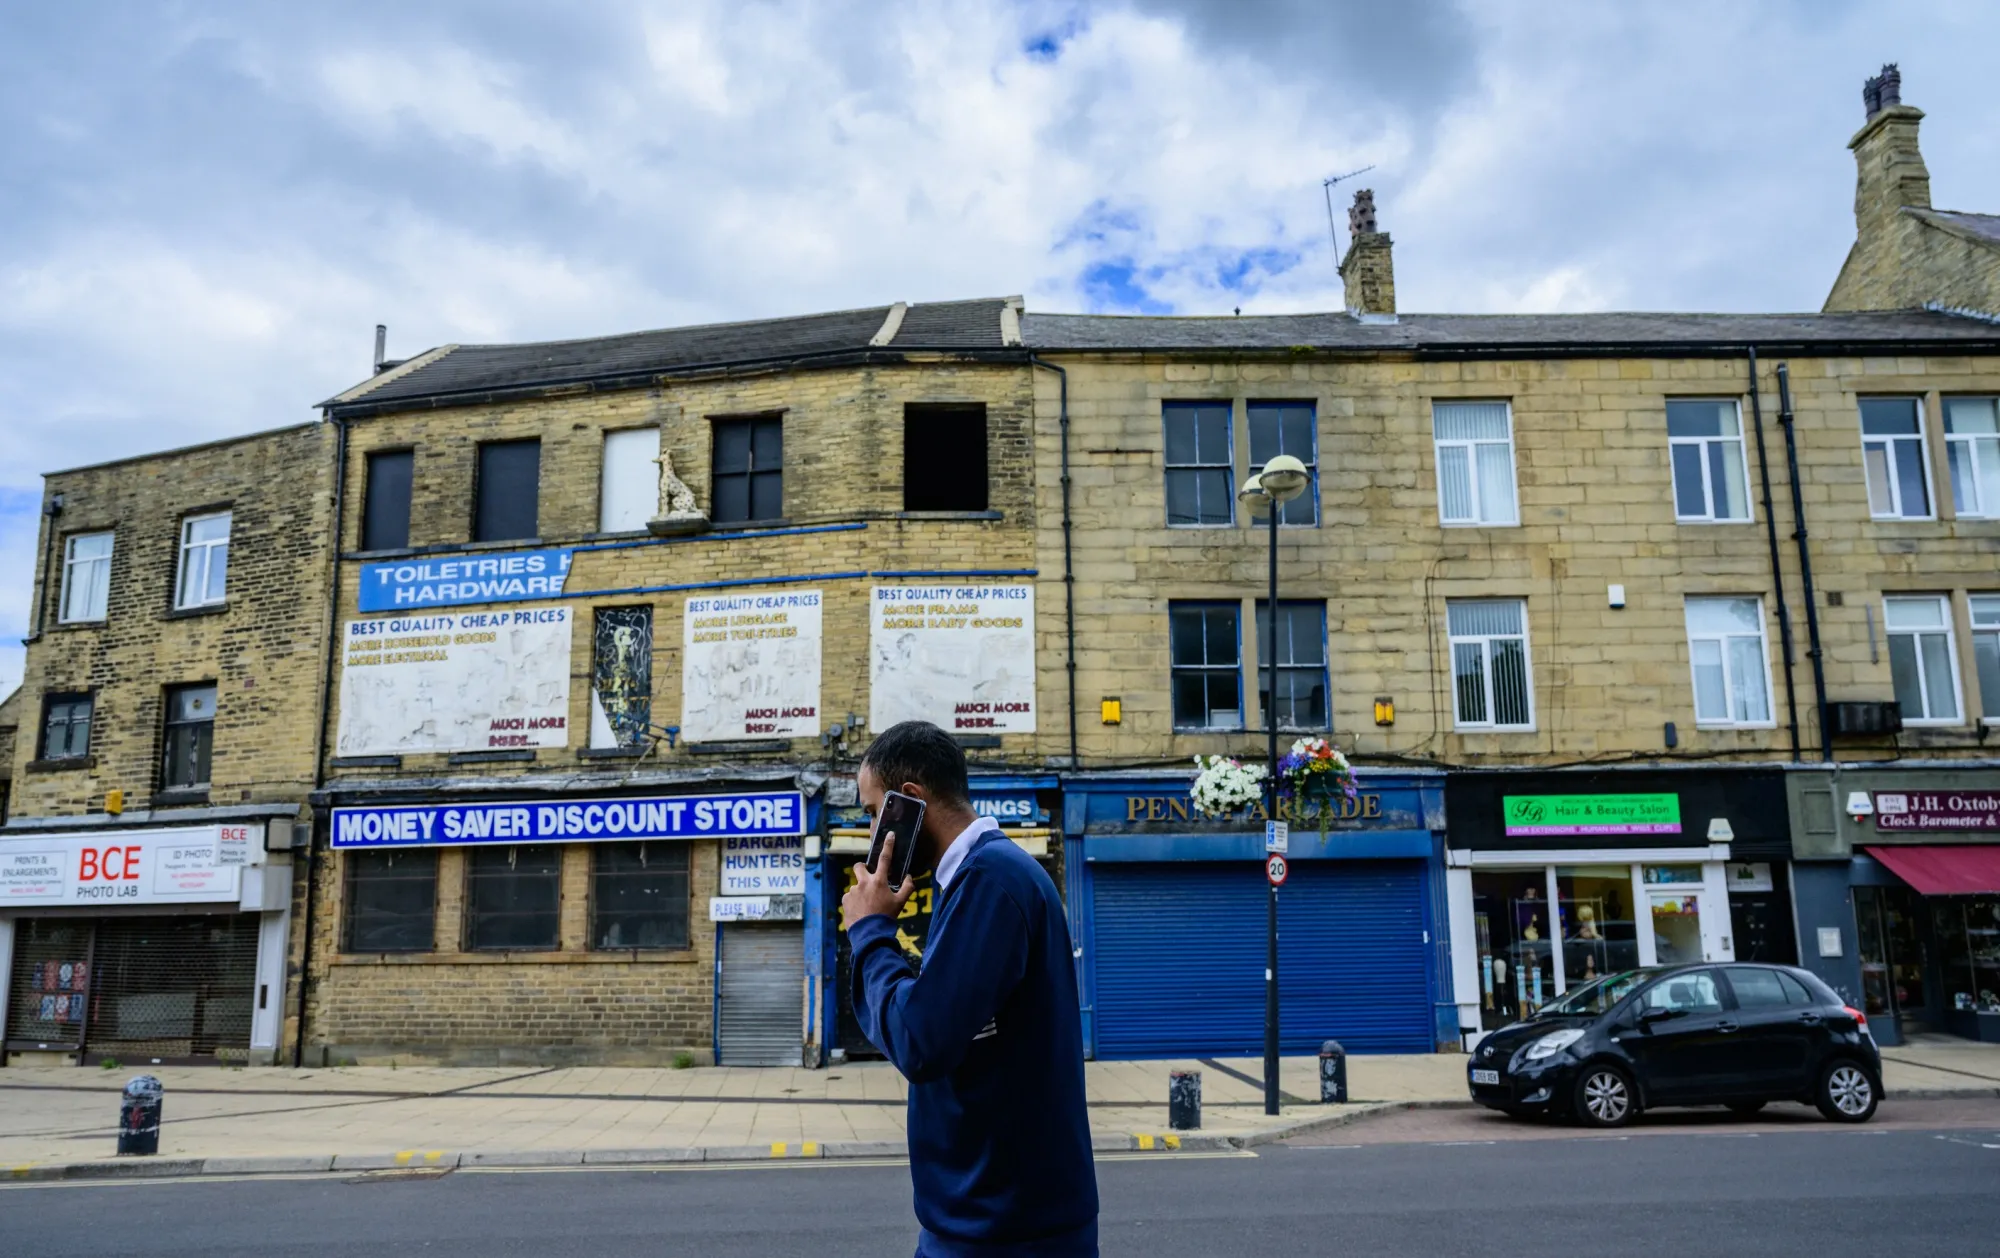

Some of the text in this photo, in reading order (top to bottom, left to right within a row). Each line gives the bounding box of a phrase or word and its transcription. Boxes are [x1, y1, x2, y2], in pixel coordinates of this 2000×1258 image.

[375, 554, 546, 584] TOILETRIES
[395, 575, 564, 604] HARDWARE
[878, 588, 1027, 600] BEST QUALITY CHEAP PRICES
[689, 594, 819, 612] BEST QUALITY CHEAP PRICES
[883, 604, 979, 616] MORE PRAMS
[351, 609, 565, 636] BEST QUALITY CHEAP PRICES
[692, 613, 788, 629] MORE LUGGAGE
[883, 617, 1023, 630] MORE BABY GOODS
[348, 632, 497, 651] MORE HOUSEHOLD GOODS
[692, 626, 798, 643] MORE TOILETRIES
[347, 650, 448, 666] MORE ELECTRICAL
[745, 707, 816, 719] MUCH MORE
[954, 702, 1030, 714] MUCH MORE
[489, 717, 566, 731] MUCH MORE
[1126, 796, 1234, 822] PEN
[1910, 796, 1944, 811] J.H.
[1555, 804, 1670, 818] Hair & Beauty Salon
[338, 798, 793, 842] MONEY SAVER DISCOUNT STORE
[1880, 814, 1997, 827] Clock Barometer &
[221, 828, 247, 840] BCE
[1512, 826, 1529, 834] HAIR
[1530, 825, 1575, 834] EXTENSIONS
[727, 835, 801, 850] BARGAIN
[14, 855, 47, 865] PRINTS &
[173, 850, 182, 860] ID
[726, 853, 801, 870] HUNTERS
[78, 846, 142, 881] BCE
[1270, 862, 1285, 876] 20
[2, 867, 58, 878] ENLARGEMENTS
[727, 875, 800, 889] THIS WAY
[76, 885, 138, 898] PHOTO LAB
[715, 902, 743, 917] PLEASE
